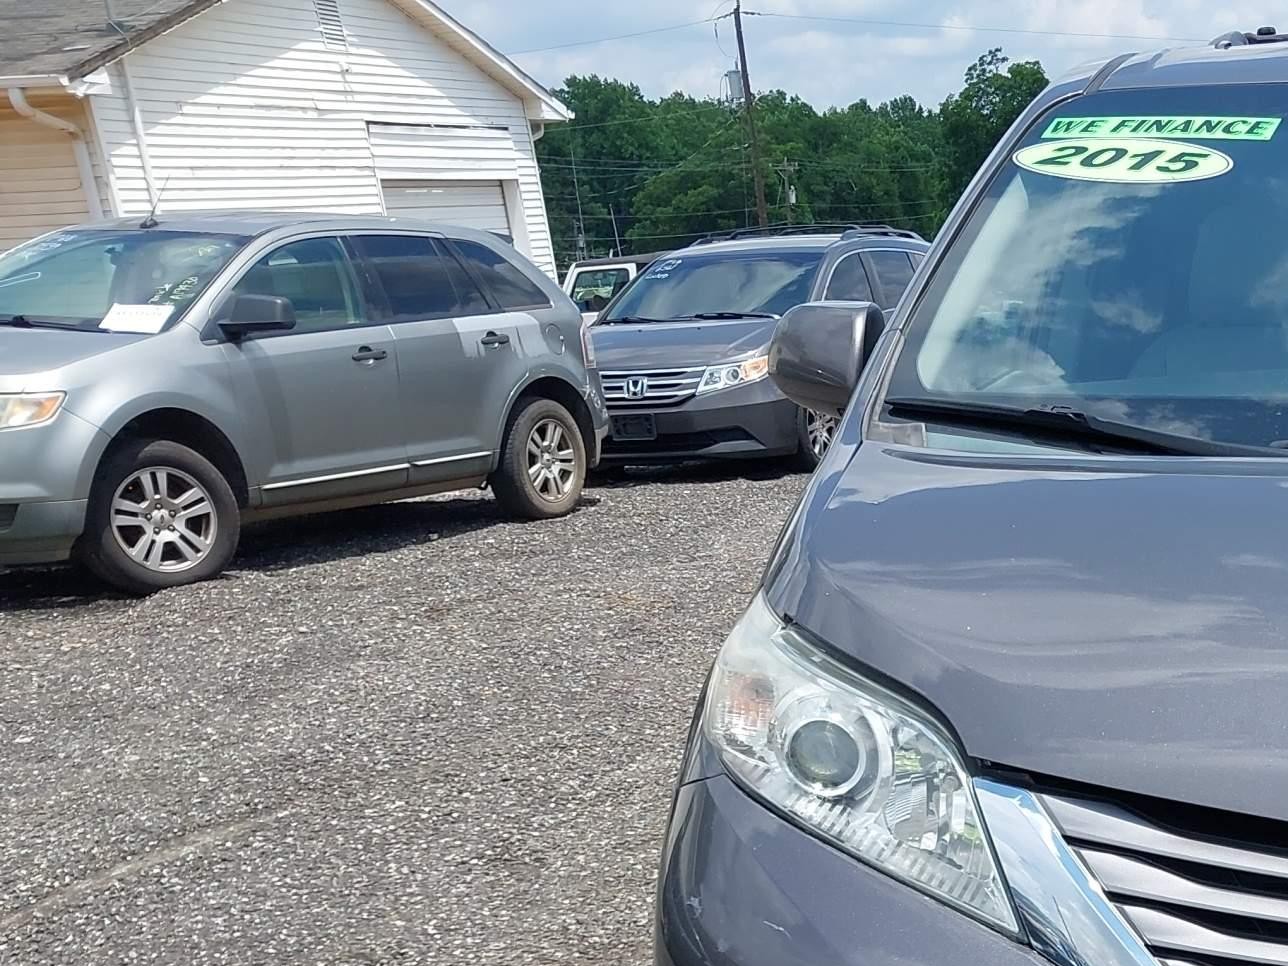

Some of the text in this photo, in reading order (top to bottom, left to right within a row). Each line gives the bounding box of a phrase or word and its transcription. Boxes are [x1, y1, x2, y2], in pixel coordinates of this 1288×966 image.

[1050, 118, 1273, 137] WE FINANCE
[1033, 145, 1211, 174] 2015
